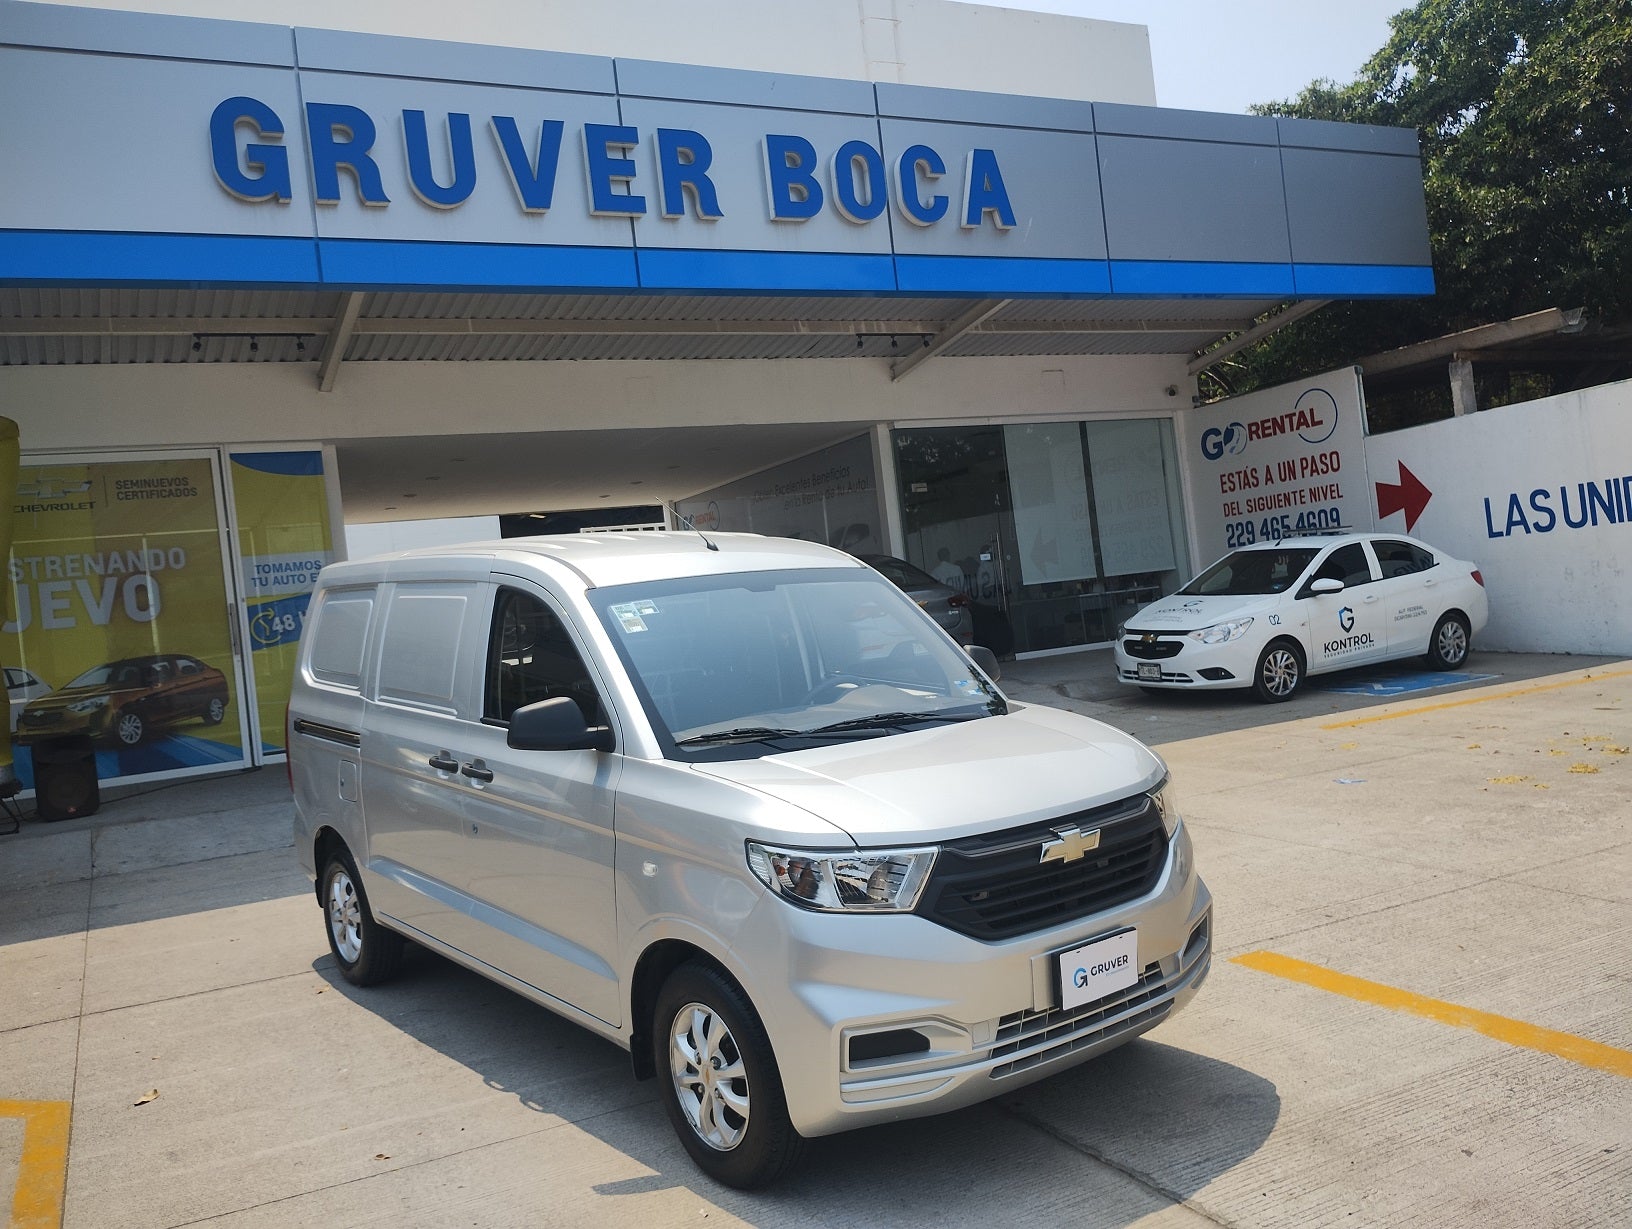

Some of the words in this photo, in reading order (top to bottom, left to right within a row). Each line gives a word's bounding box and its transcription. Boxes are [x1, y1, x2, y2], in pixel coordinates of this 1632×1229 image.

[209, 96, 724, 222] GRUVER
[761, 132, 1016, 231] BOCA
[1247, 408, 1324, 442] RENTAL
[1220, 465, 1260, 494] ESTÁS
[1264, 464, 1275, 486] A
[1277, 459, 1297, 483] UN
[1300, 450, 1341, 480] PASO
[115, 477, 189, 491] SEMINUEVOS
[116, 487, 198, 501] CERTIFICADOS
[1223, 503, 1243, 518] DEL
[1246, 489, 1306, 515] SIGUIENTE
[1309, 483, 1344, 502] NIVEL
[1483, 488, 1557, 539] LAS
[1226, 520, 1256, 548] 229
[255, 560, 322, 575] TOMAMOS
[251, 576, 269, 587] TU
[272, 573, 307, 586] AUTO
[310, 572, 320, 583] E
[272, 614, 296, 633] 48
[1323, 632, 1375, 654] KONTROL
[1090, 954, 1129, 977] GRUVER
